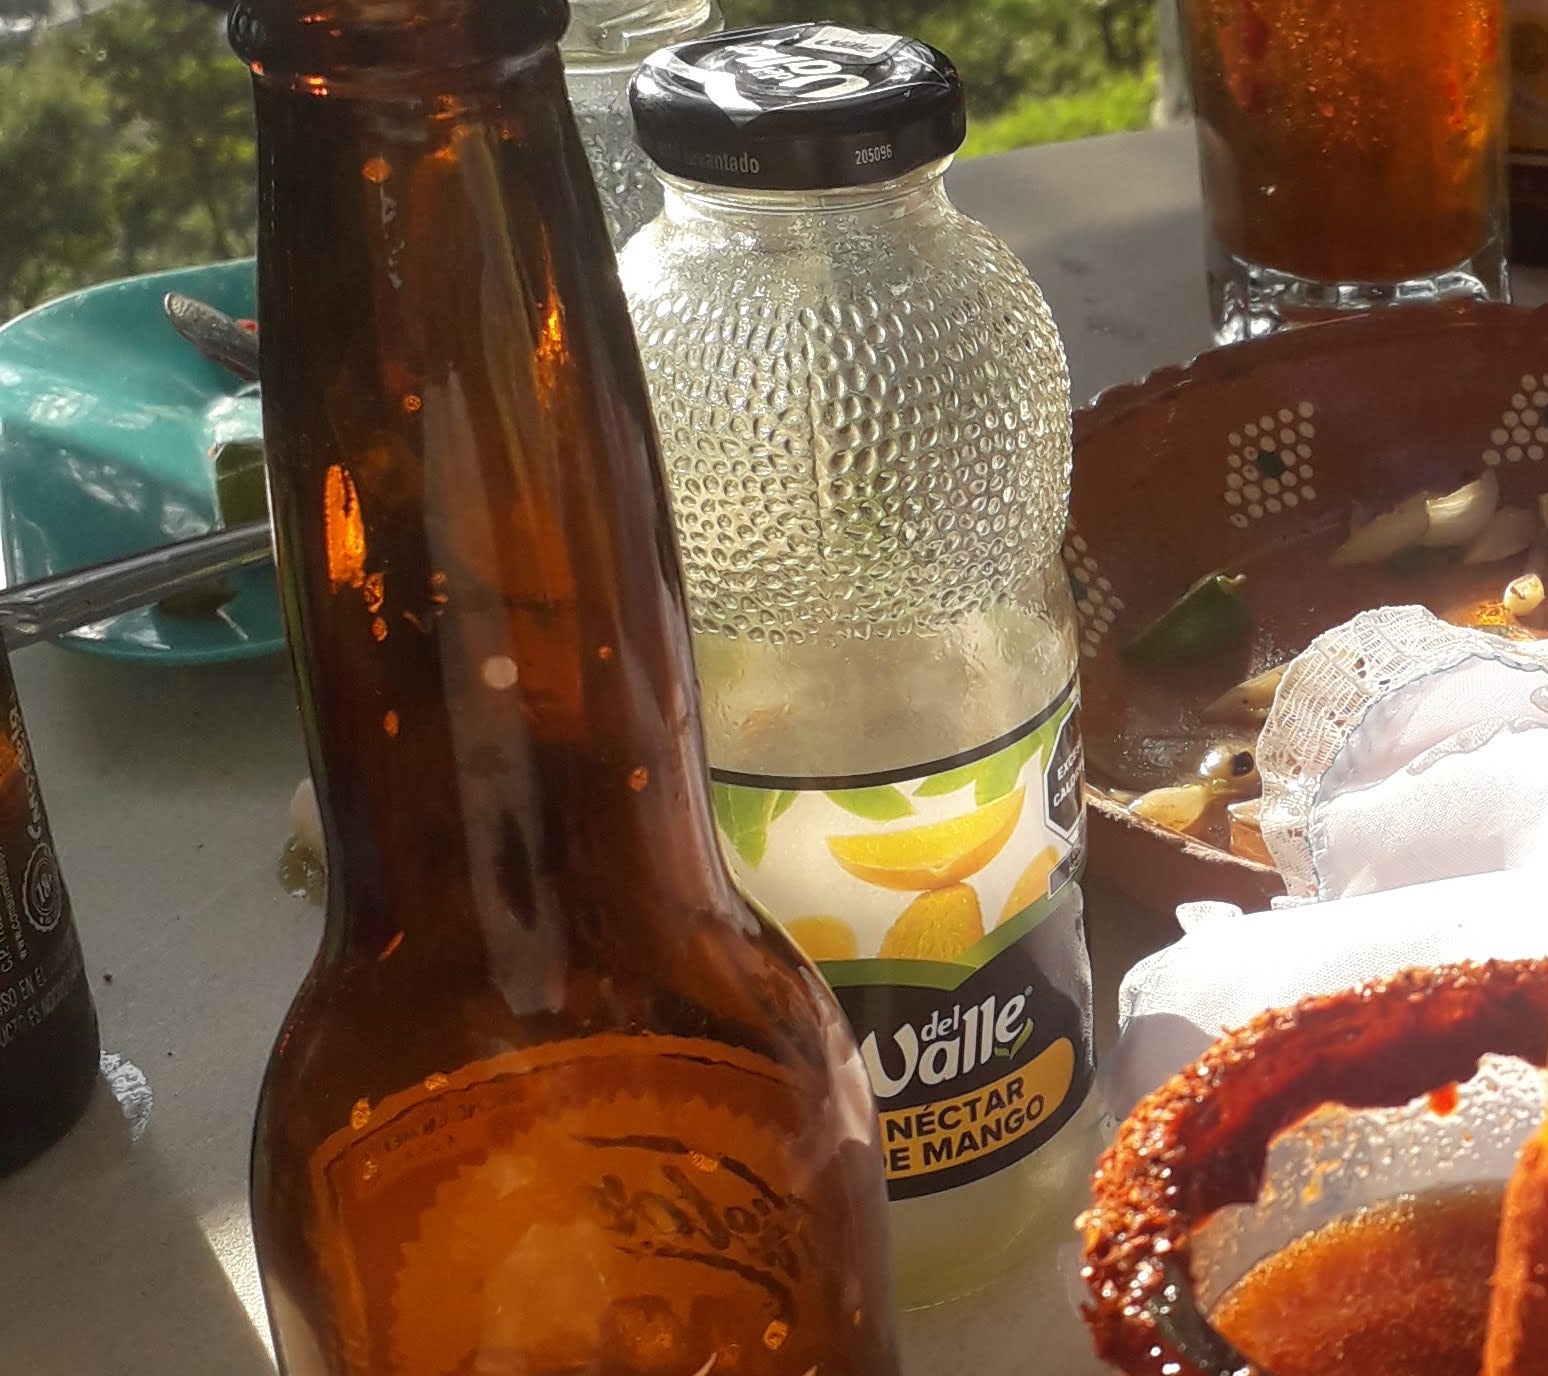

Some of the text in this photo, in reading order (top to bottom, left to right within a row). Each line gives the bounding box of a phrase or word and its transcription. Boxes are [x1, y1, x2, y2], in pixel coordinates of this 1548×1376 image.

[854, 143, 893, 166] 205096
[861, 994, 1027, 1099] Valle
[920, 1001, 960, 1044] del
[885, 1076, 1025, 1143] NÉCTAR
[922, 1093, 1045, 1164] MANGO
